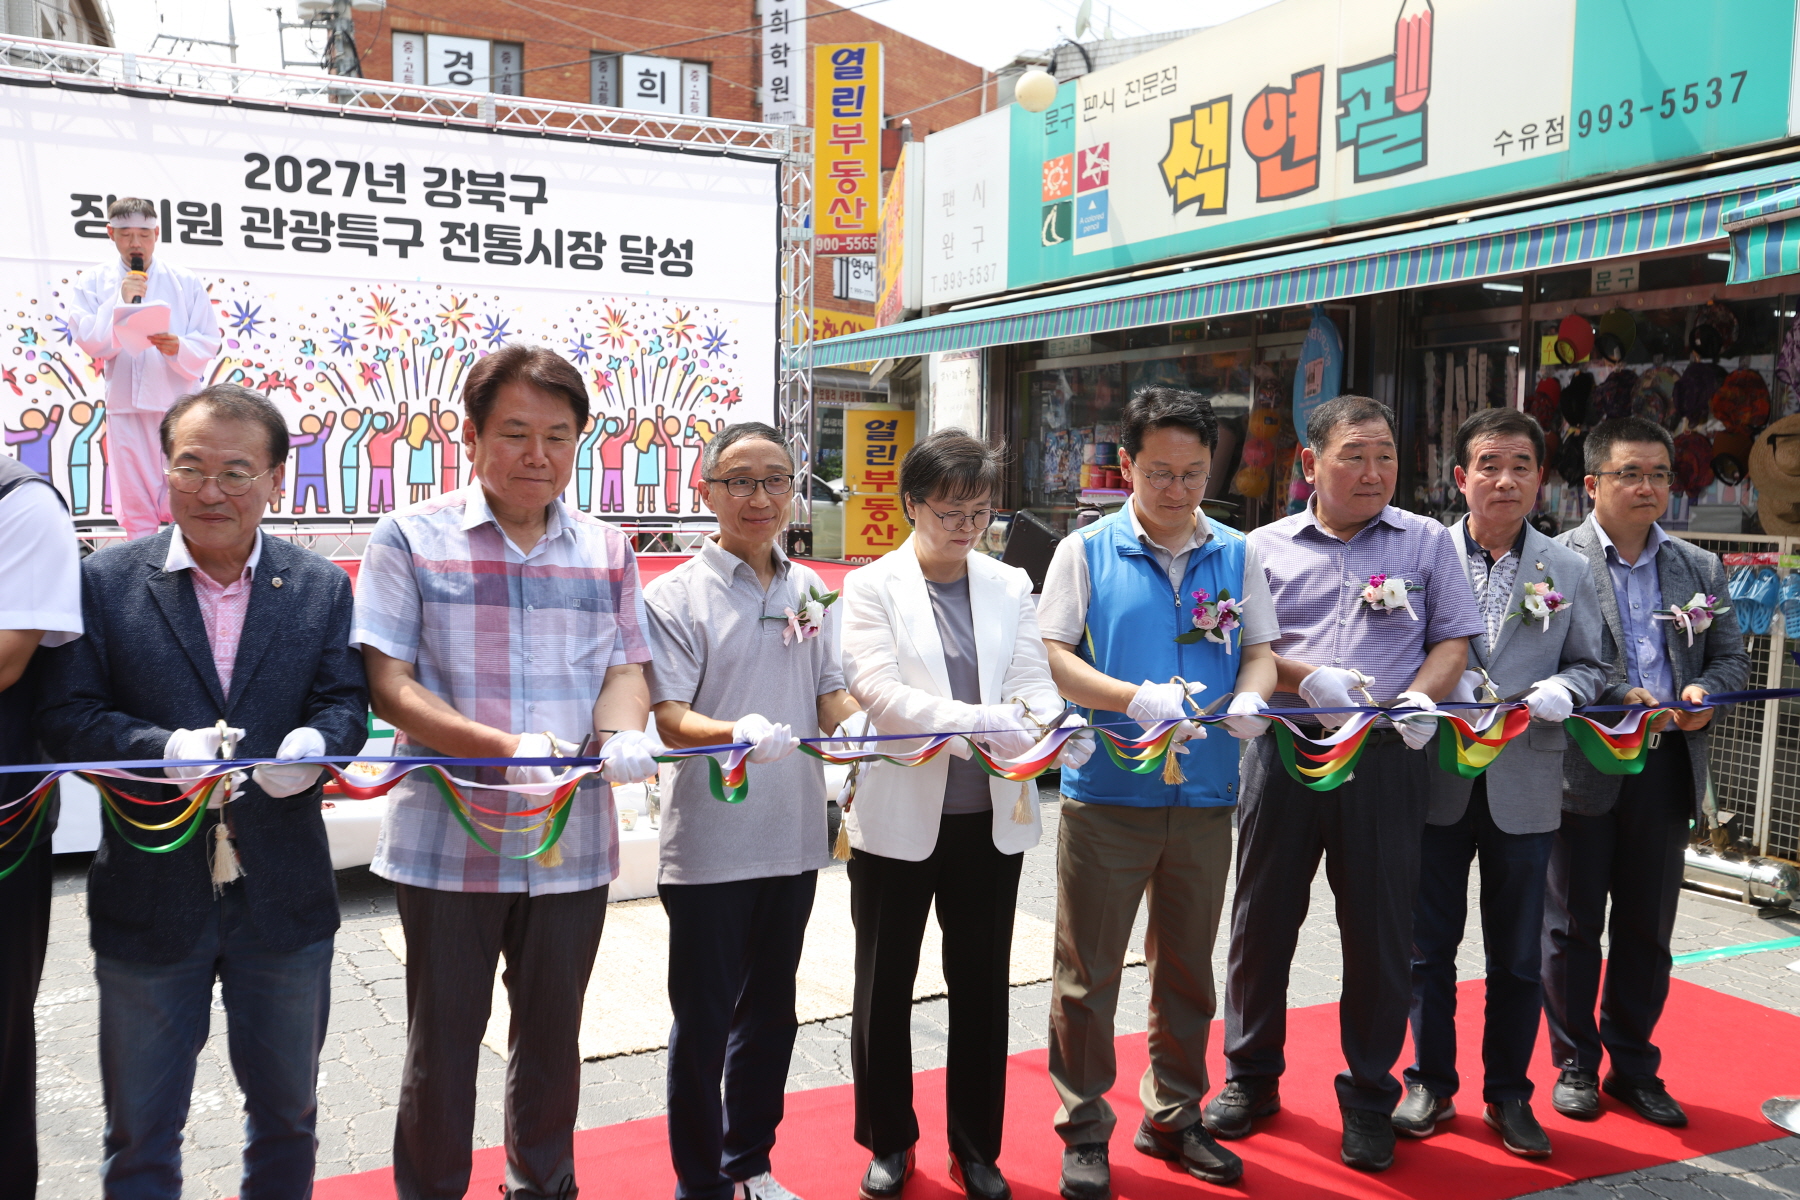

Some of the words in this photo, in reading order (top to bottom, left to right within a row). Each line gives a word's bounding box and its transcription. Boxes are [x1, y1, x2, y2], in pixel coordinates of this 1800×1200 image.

[444, 50, 473, 86] 경
[770, 0, 791, 103] 희학원
[637, 68, 666, 105] 희
[828, 47, 868, 229] 열린부동산
[1045, 103, 1075, 136] 문구
[1493, 115, 1565, 157] 수유점
[1577, 70, 1749, 139] 993-5537
[244, 152, 407, 205] 2027년
[423, 166, 548, 215] 강북구
[240, 205, 425, 259] 관광특구
[440, 221, 607, 271] 전통시장
[620, 233, 694, 278] 달성
[816, 236, 877, 251] 900-5565
[942, 225, 985, 260] 완구
[1596, 267, 1635, 292] 문구
[860, 419, 899, 547] 열린부동산
